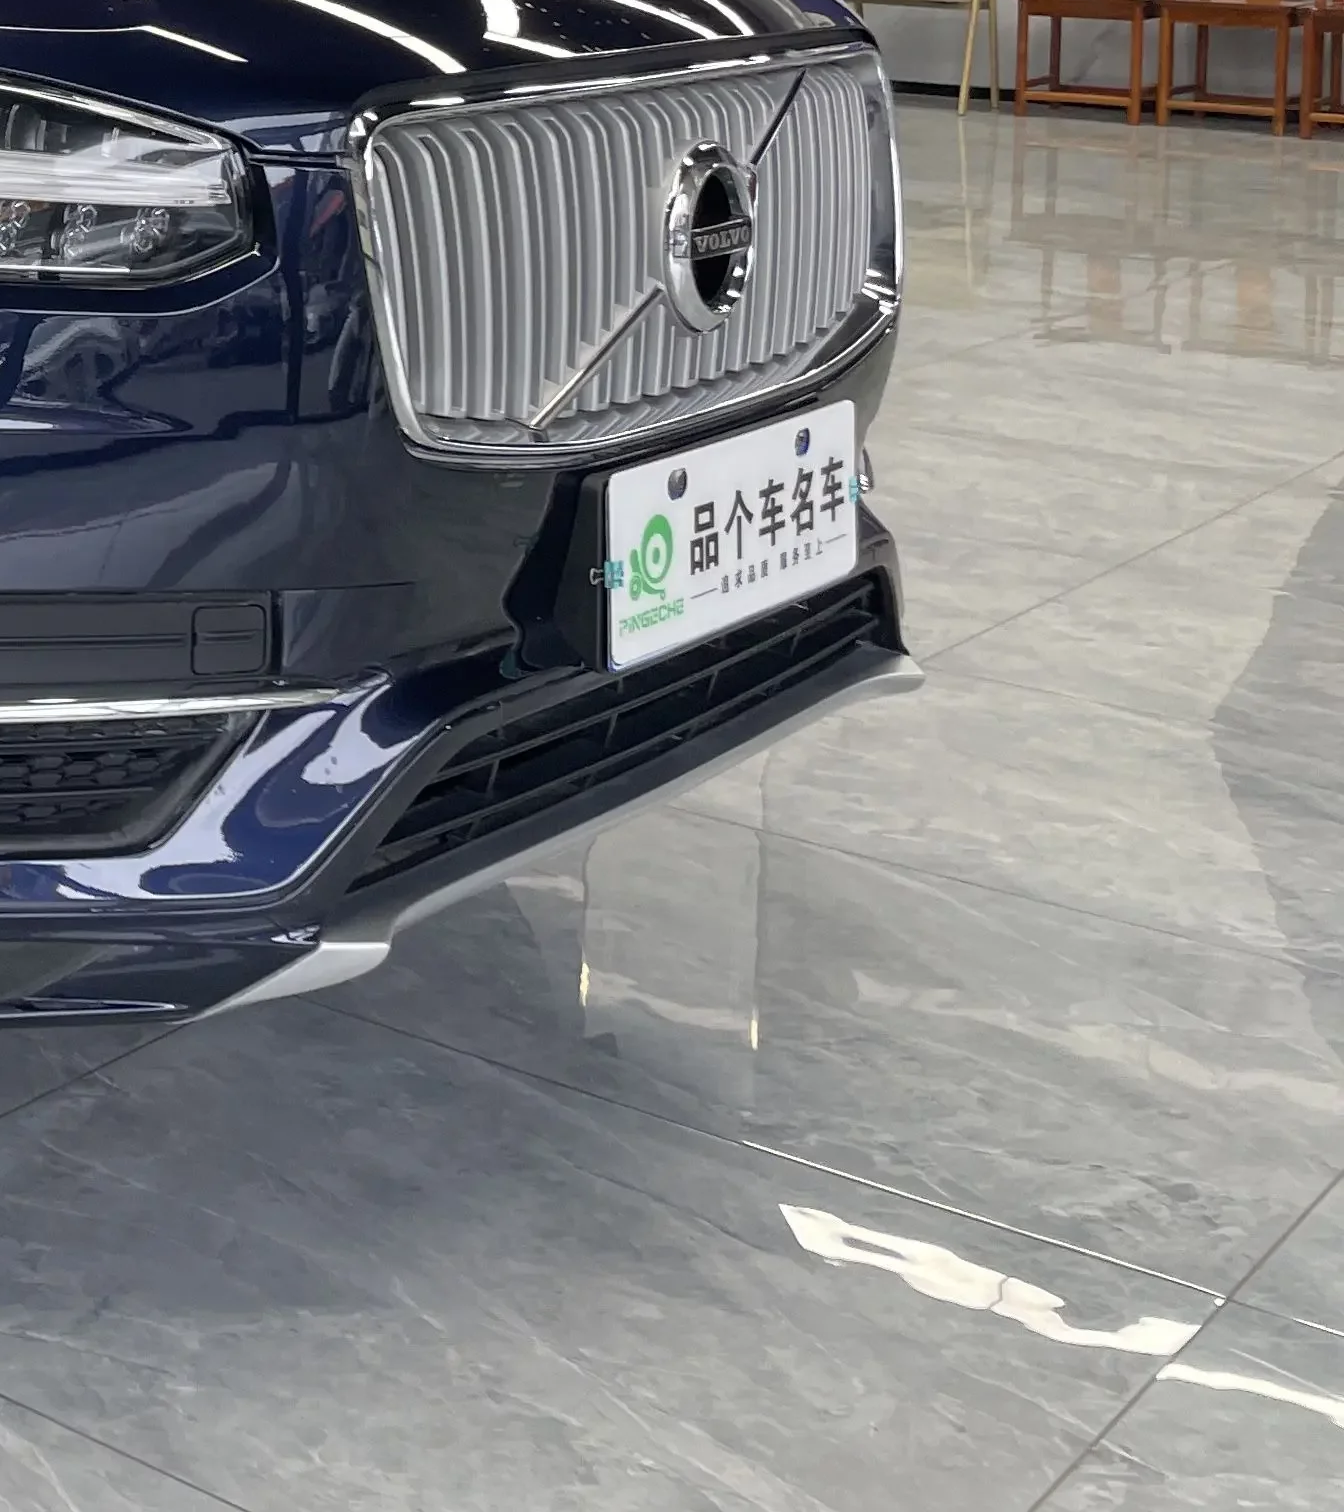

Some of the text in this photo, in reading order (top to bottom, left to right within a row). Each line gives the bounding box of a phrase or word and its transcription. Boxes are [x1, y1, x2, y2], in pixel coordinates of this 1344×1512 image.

[694, 225, 750, 253] VOLVO
[690, 457, 845, 575] 品个车名车
